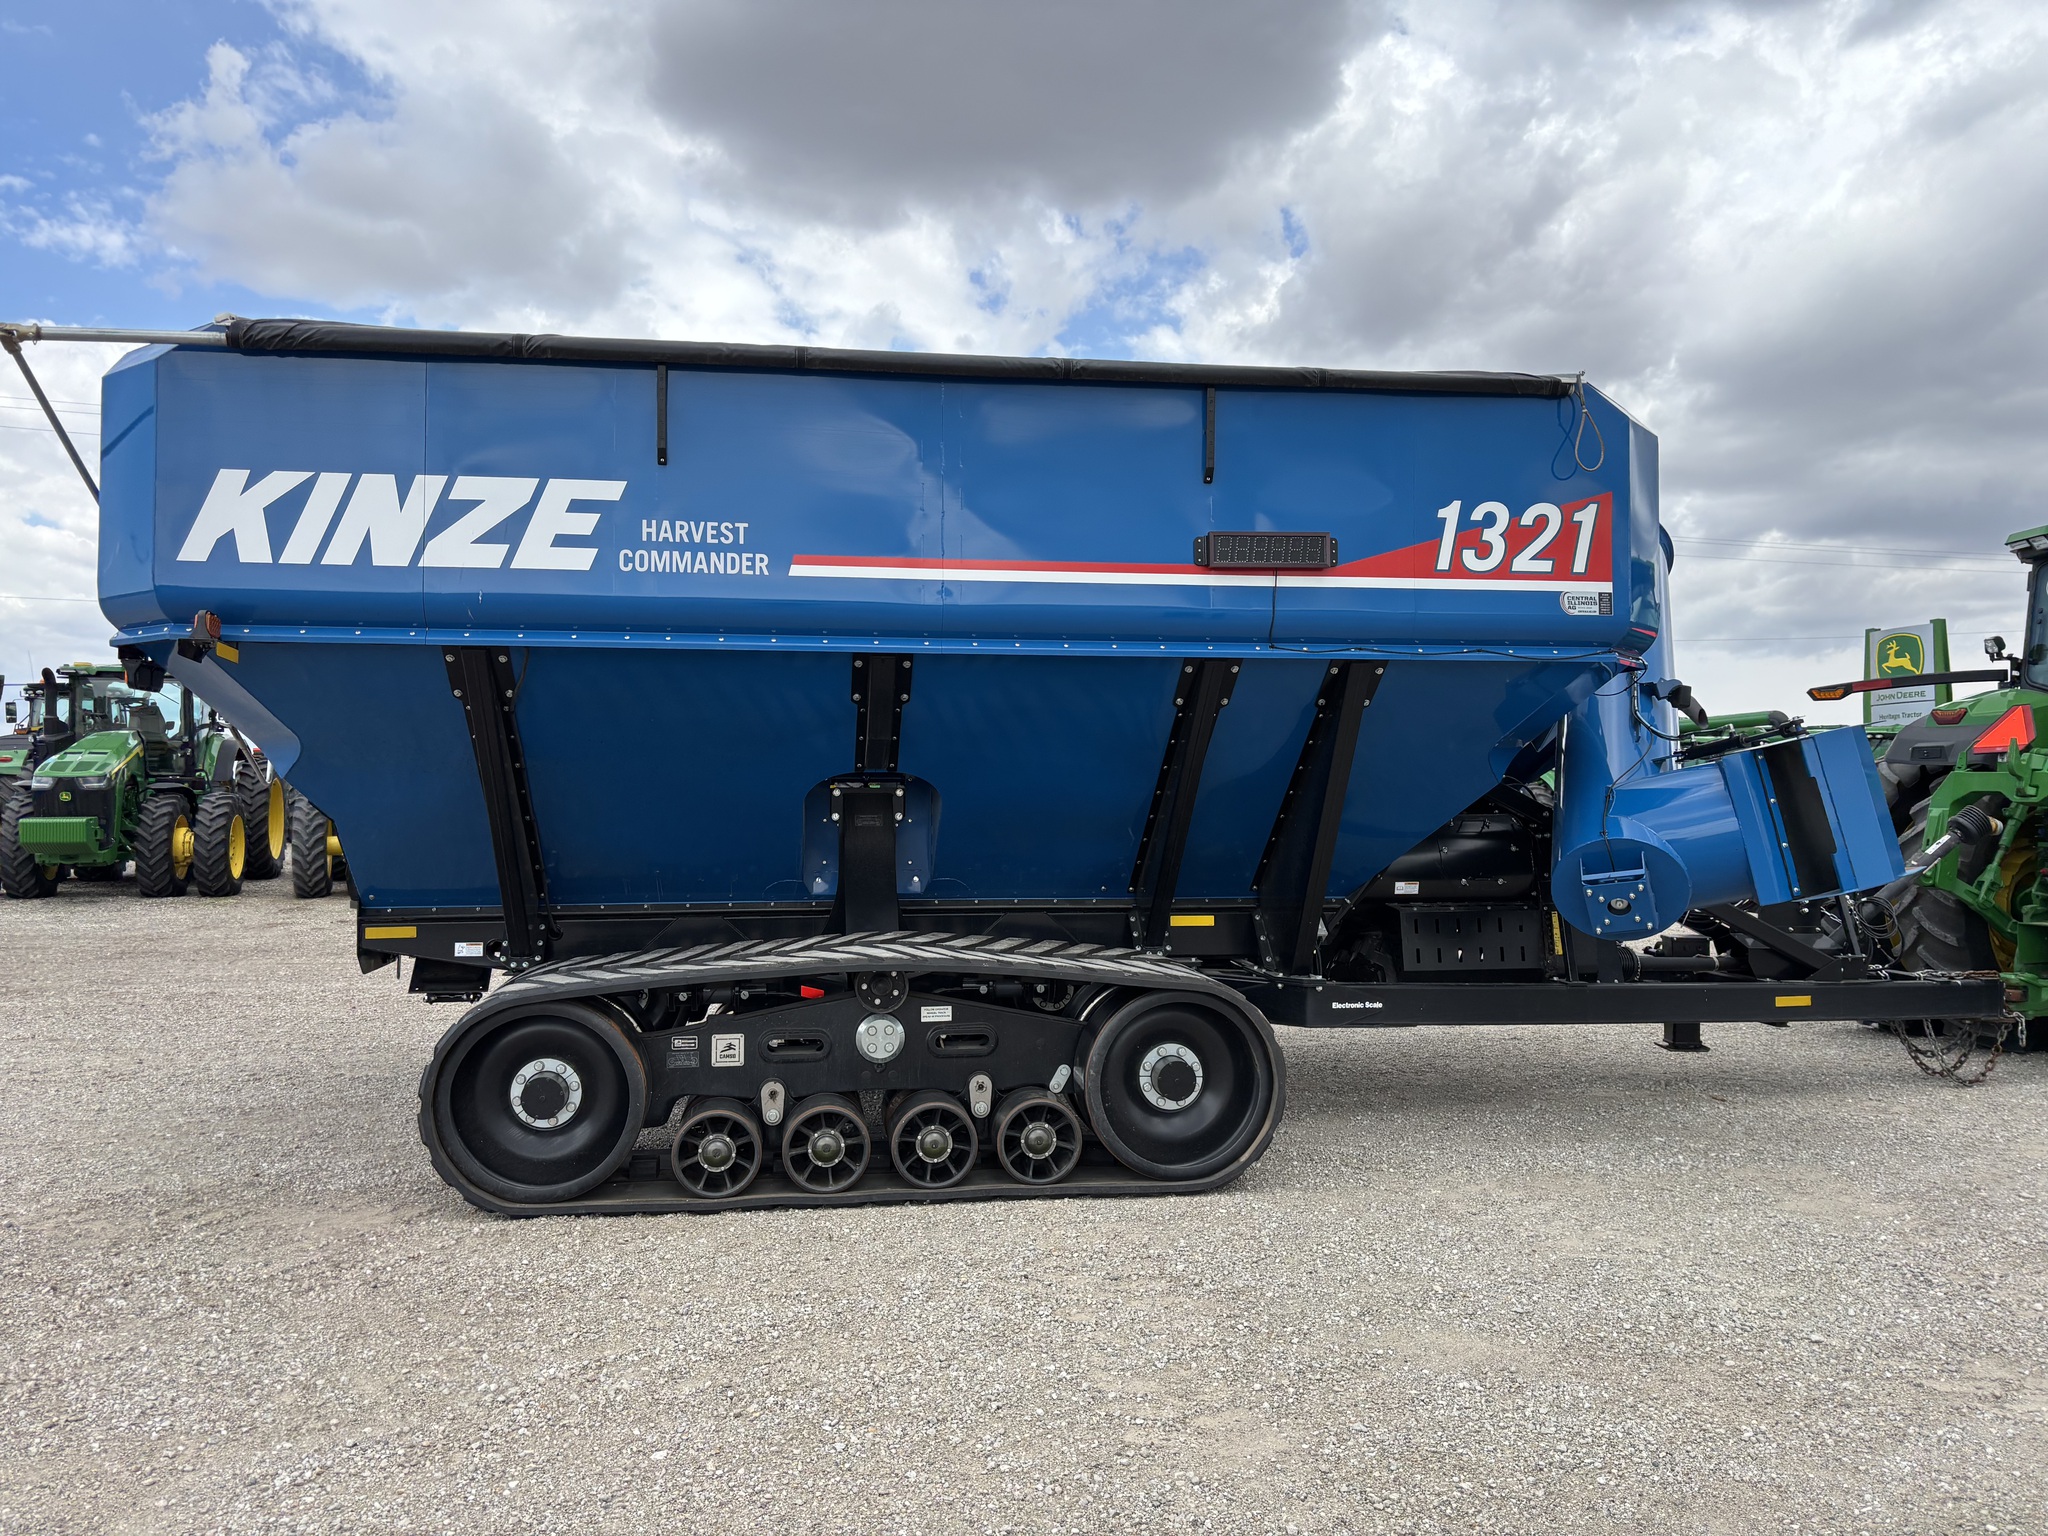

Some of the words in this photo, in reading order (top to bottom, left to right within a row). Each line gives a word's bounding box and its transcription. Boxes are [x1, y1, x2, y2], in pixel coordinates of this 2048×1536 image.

[176, 468, 628, 571] KINZE
[641, 519, 749, 545] HARVEST
[1435, 499, 1600, 575] 1321
[618, 549, 770, 576] COMMANDER
[1876, 692, 1895, 702] JOHN
[1896, 690, 1927, 700] DEERE
[1901, 711, 1922, 719] Tractor
[1331, 1001, 1364, 1009] Electronic
[1364, 1001, 1383, 1009] Scale
